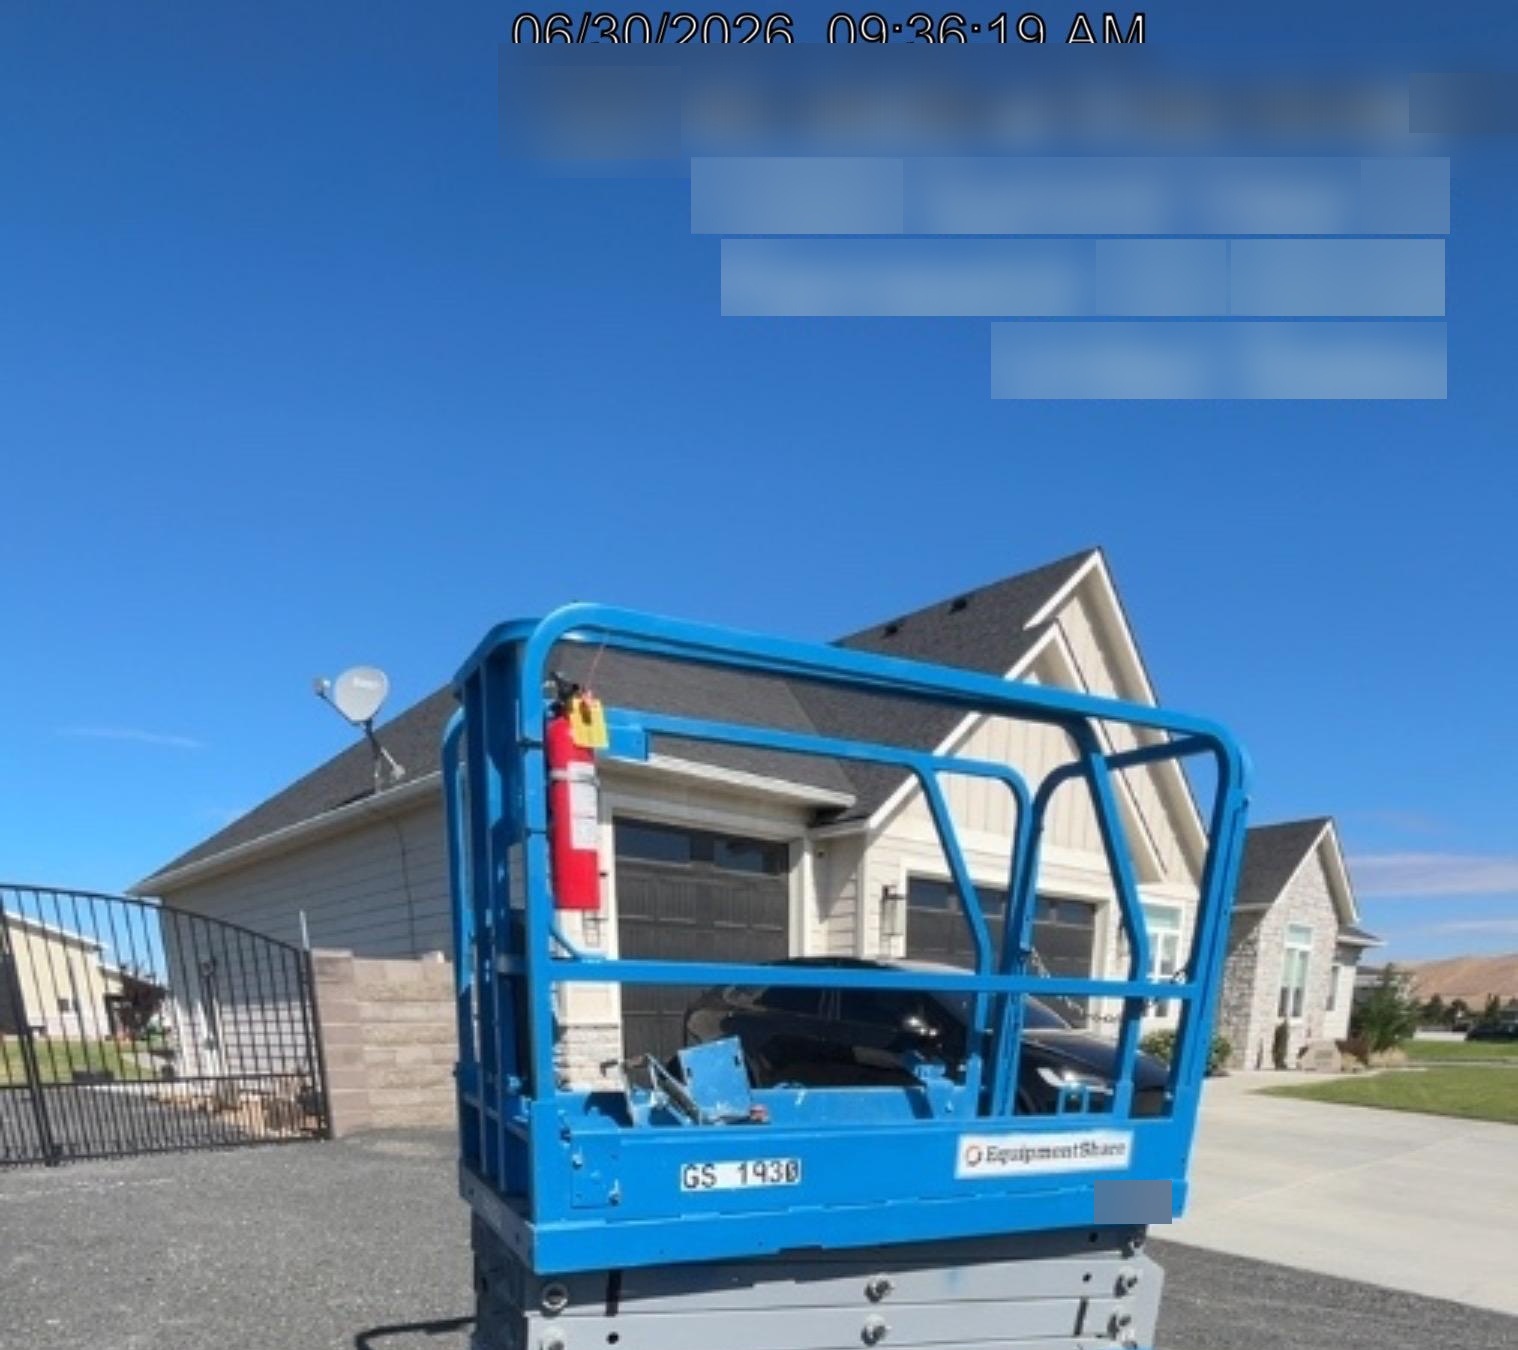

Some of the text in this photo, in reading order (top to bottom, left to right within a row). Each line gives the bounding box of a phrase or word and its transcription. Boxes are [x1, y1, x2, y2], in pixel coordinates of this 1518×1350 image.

[986, 1140, 1125, 1166] EquipmentShare
[684, 1159, 799, 1189] GS 1930
